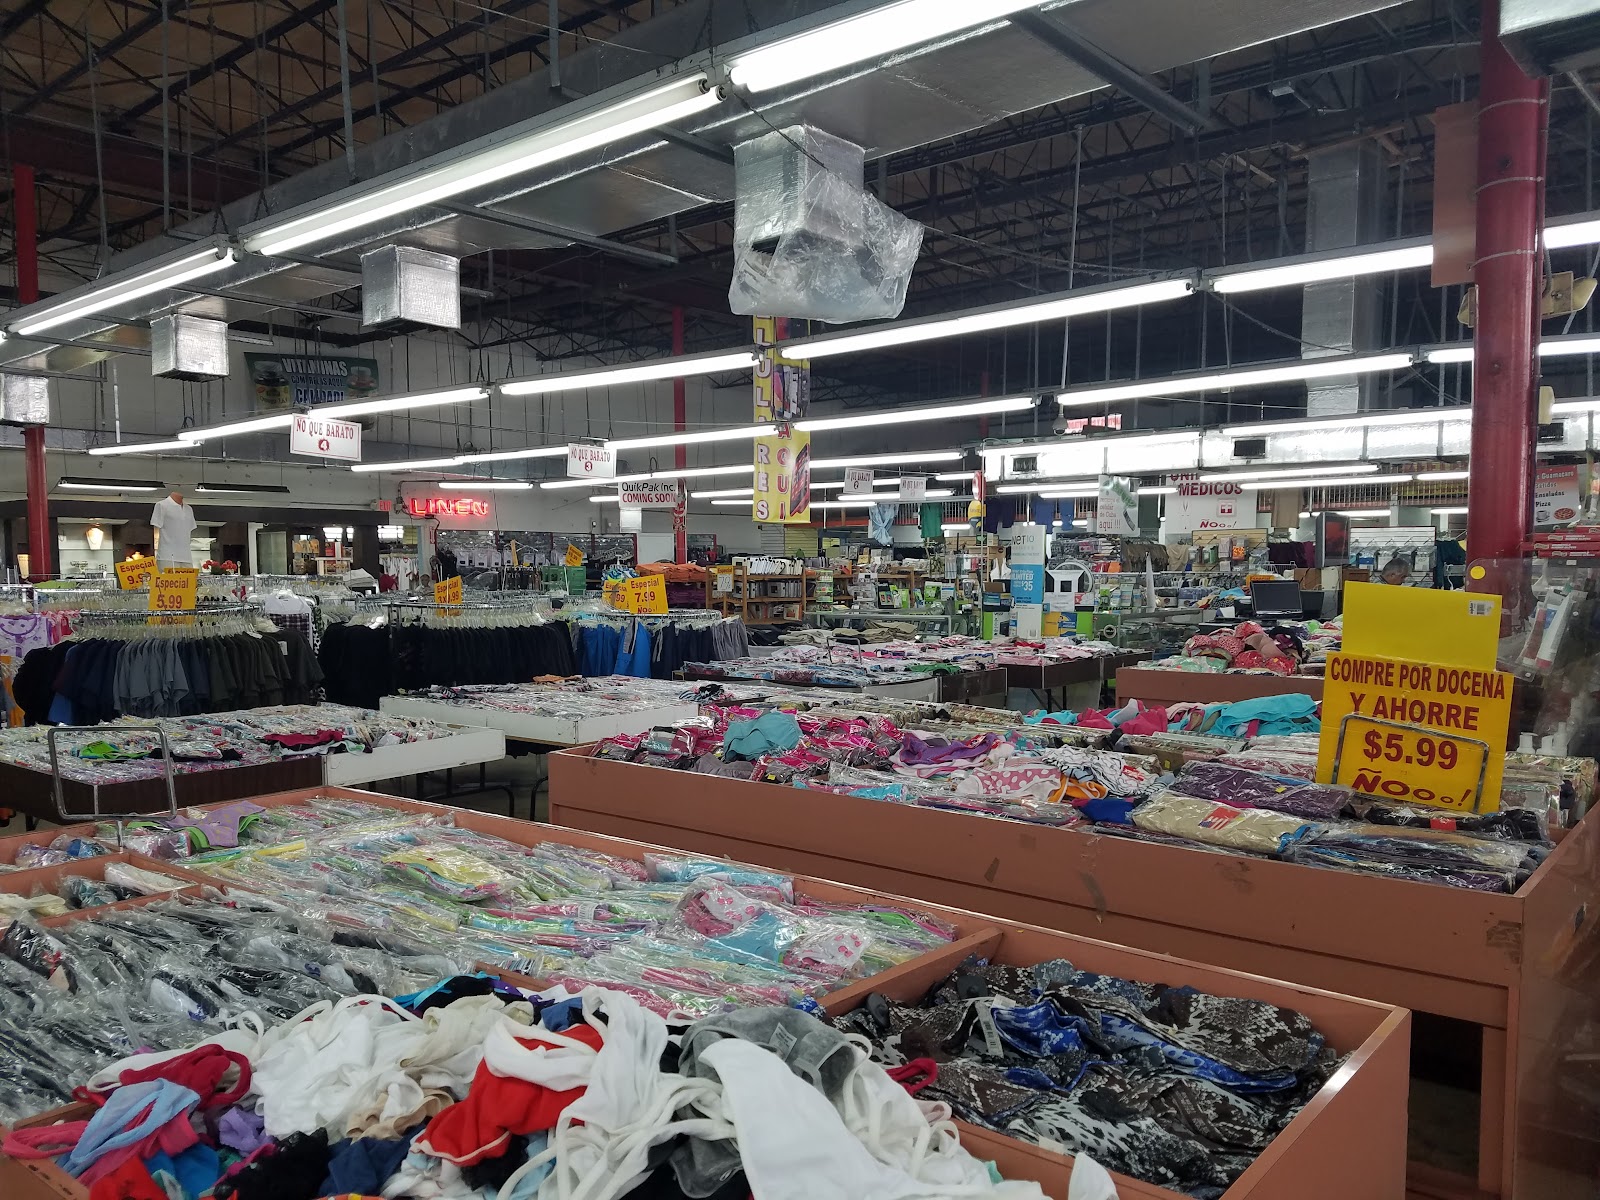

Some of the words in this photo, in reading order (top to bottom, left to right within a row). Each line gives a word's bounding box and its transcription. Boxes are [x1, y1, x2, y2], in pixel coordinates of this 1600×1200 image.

[296, 418, 307, 433] NO
[309, 420, 324, 437] QUE
[326, 423, 354, 440] BARATO
[319, 439, 330, 451] 4
[571, 447, 577, 459] NO
[578, 449, 588, 461] QUE
[590, 449, 611, 462] BARATO
[585, 461, 593, 471] 3
[621, 482, 660, 492] QuikPak
[661, 482, 676, 492] Inc.
[1179, 482, 1243, 496] MEDICOS
[622, 493, 653, 503] COMING
[655, 493, 676, 503] SOON
[410, 498, 488, 516] LINEN
[120, 560, 155, 574] Especial
[155, 577, 189, 591] Especial
[437, 579, 459, 593] Espcial
[605, 582, 628, 592] Espcia
[630, 578, 660, 590] Especial
[157, 594, 183, 609] 5.99
[634, 591, 656, 603] 7.99
[1331, 656, 1395, 687] COMPRE
[1400, 664, 1432, 691] POR
[1436, 668, 1506, 700] DOCENA
[1350, 692, 1367, 714] Y
[1372, 695, 1480, 731] AHORRE
[1363, 729, 1459, 770] $5.99
